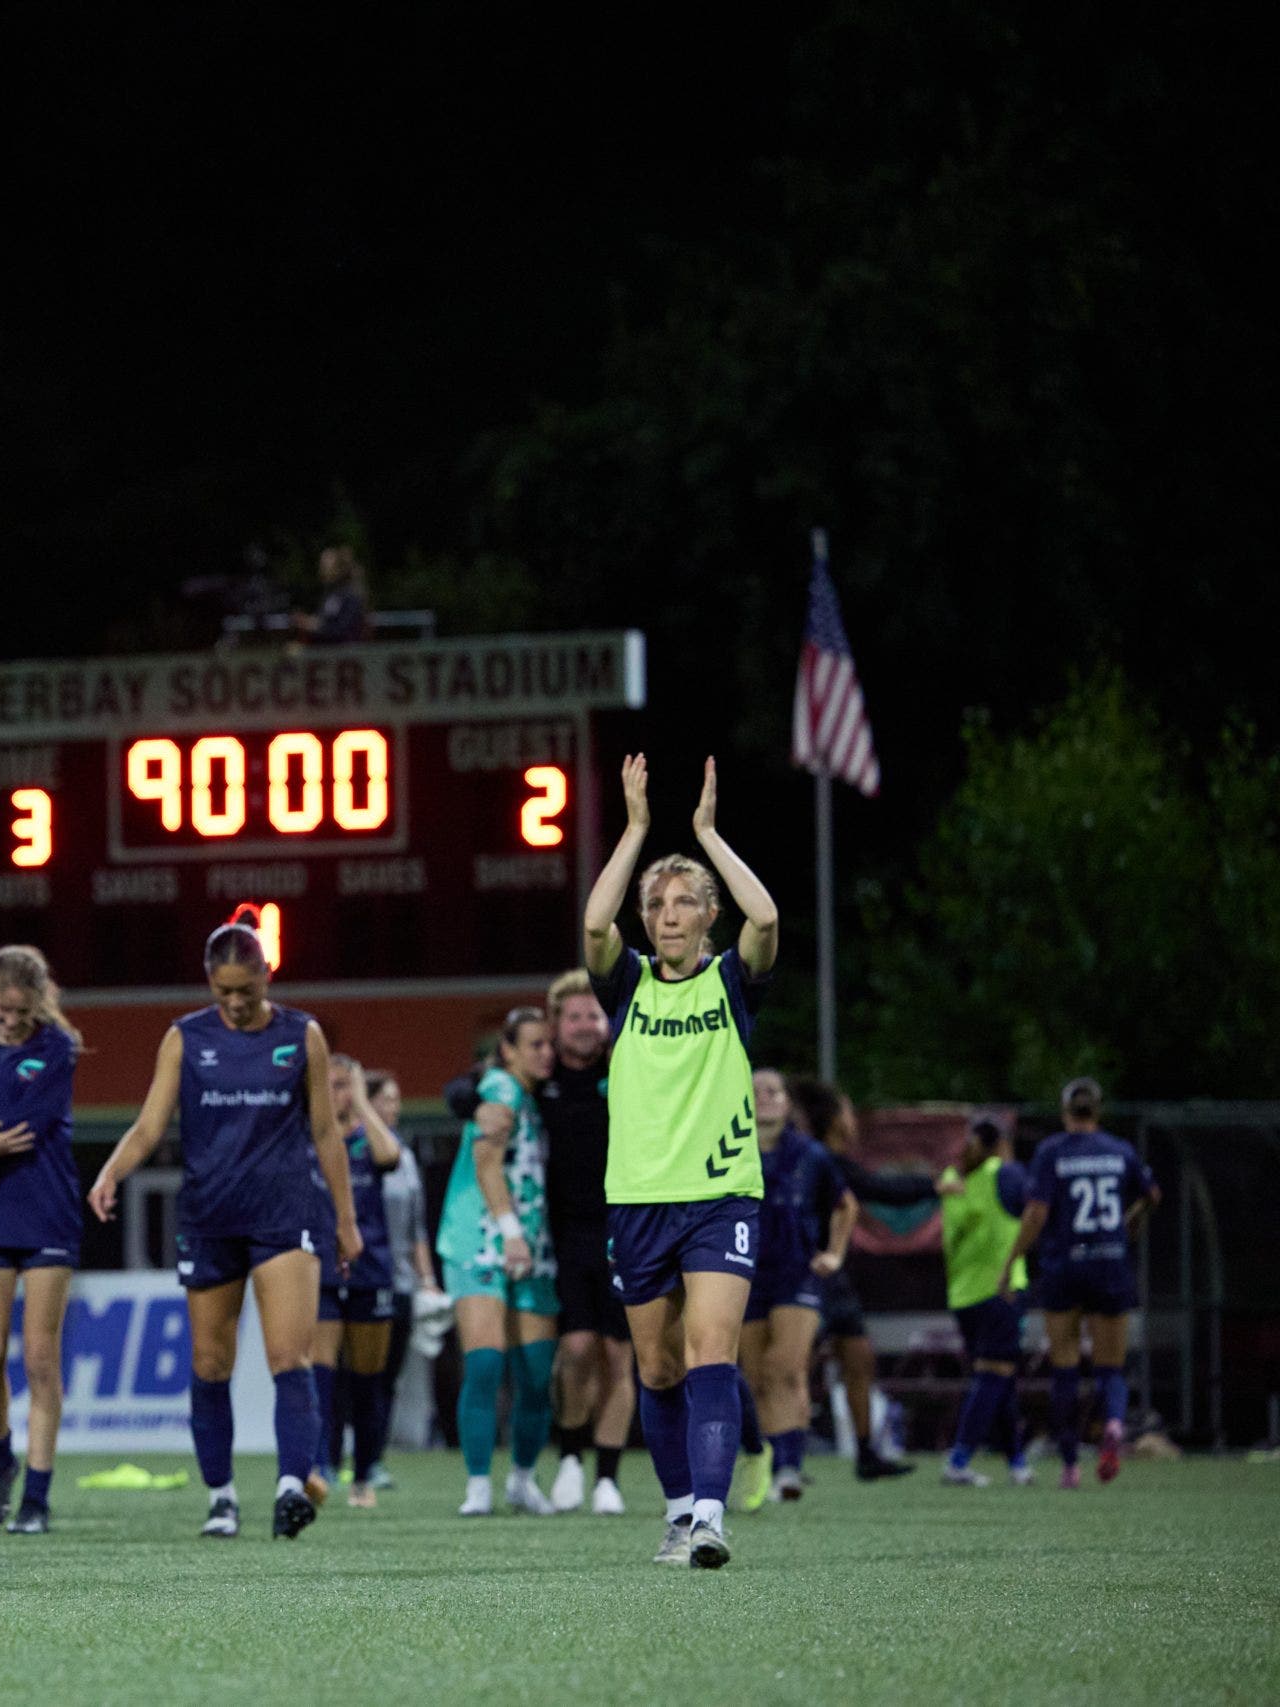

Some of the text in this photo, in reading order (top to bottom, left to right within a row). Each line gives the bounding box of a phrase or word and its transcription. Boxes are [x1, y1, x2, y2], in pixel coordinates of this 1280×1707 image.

[170, 657, 364, 715] SOCCER
[387, 645, 617, 703] STADIUM
[11, 788, 52, 867] 3
[521, 766, 567, 846] 2
[630, 998, 729, 1037] hummel
[1070, 1176, 1121, 1233] 25
[734, 1221, 749, 1254] 8
